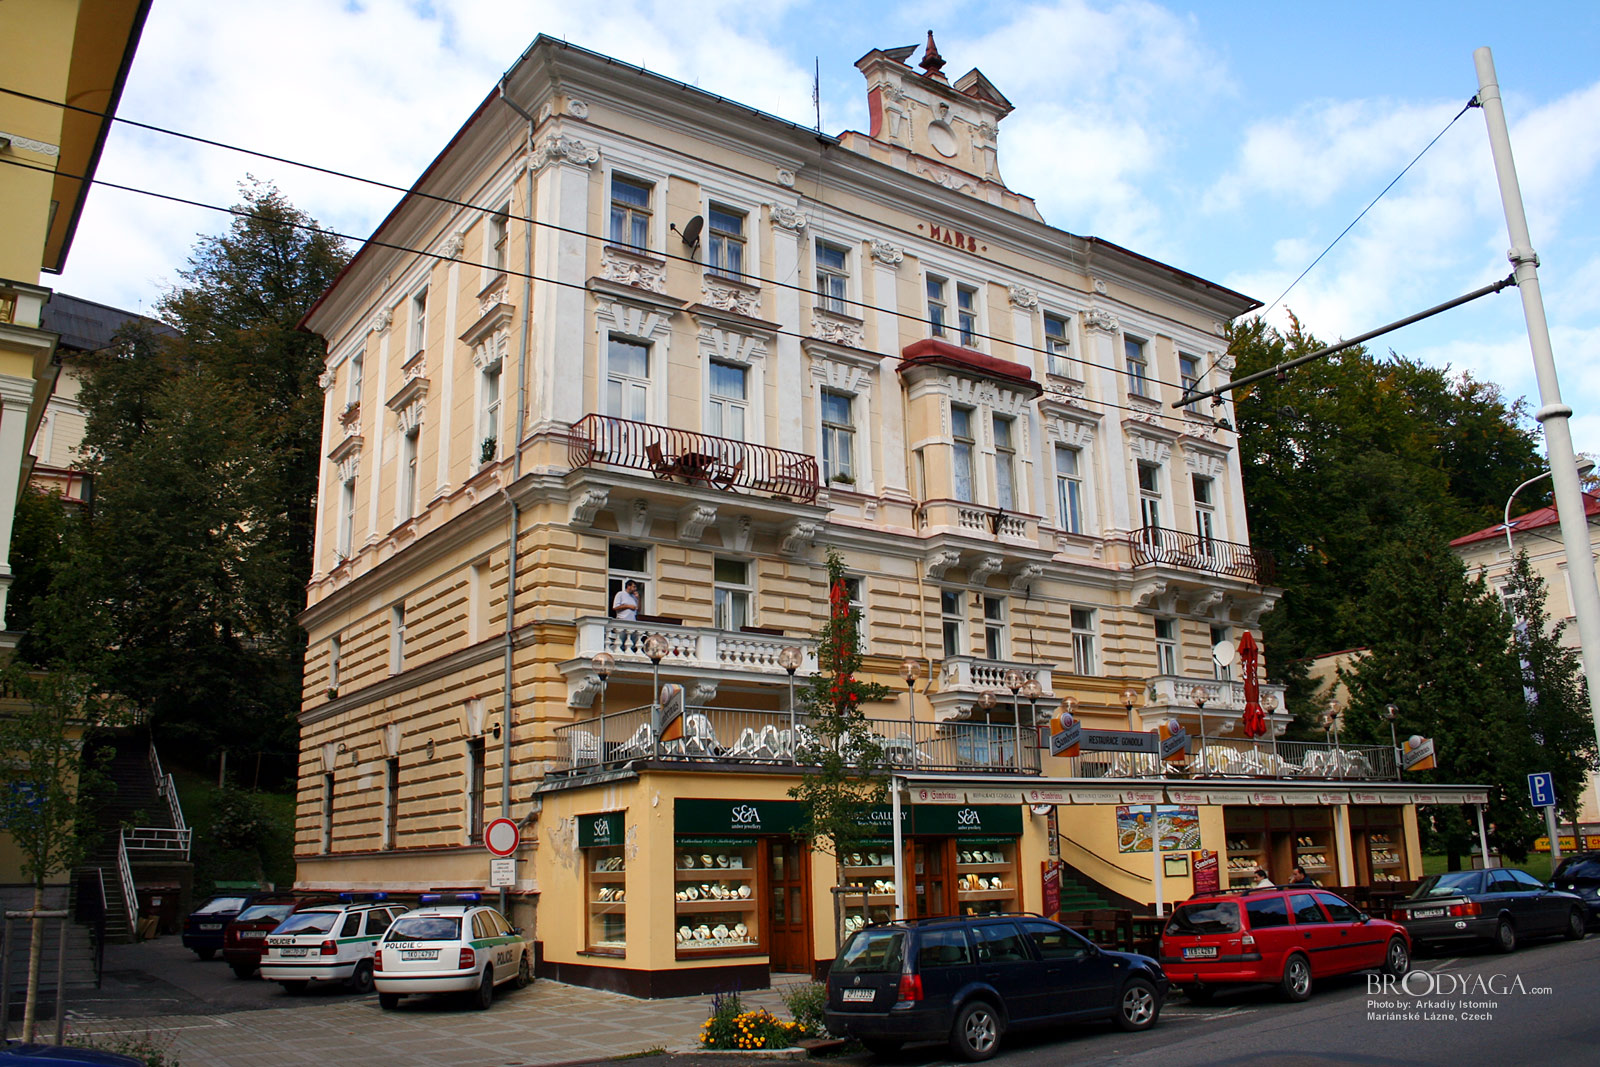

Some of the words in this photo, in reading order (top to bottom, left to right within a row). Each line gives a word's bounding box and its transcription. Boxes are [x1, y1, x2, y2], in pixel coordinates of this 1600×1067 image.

[930, 222, 977, 252] MARS
[1088, 735, 1119, 746] RESTAURACE
[1121, 737, 1144, 747] GONDOLA
[731, 804, 761, 823] S&A
[871, 811, 908, 820] GALLY
[957, 808, 981, 825] S&A
[593, 818, 610, 836] S&A
